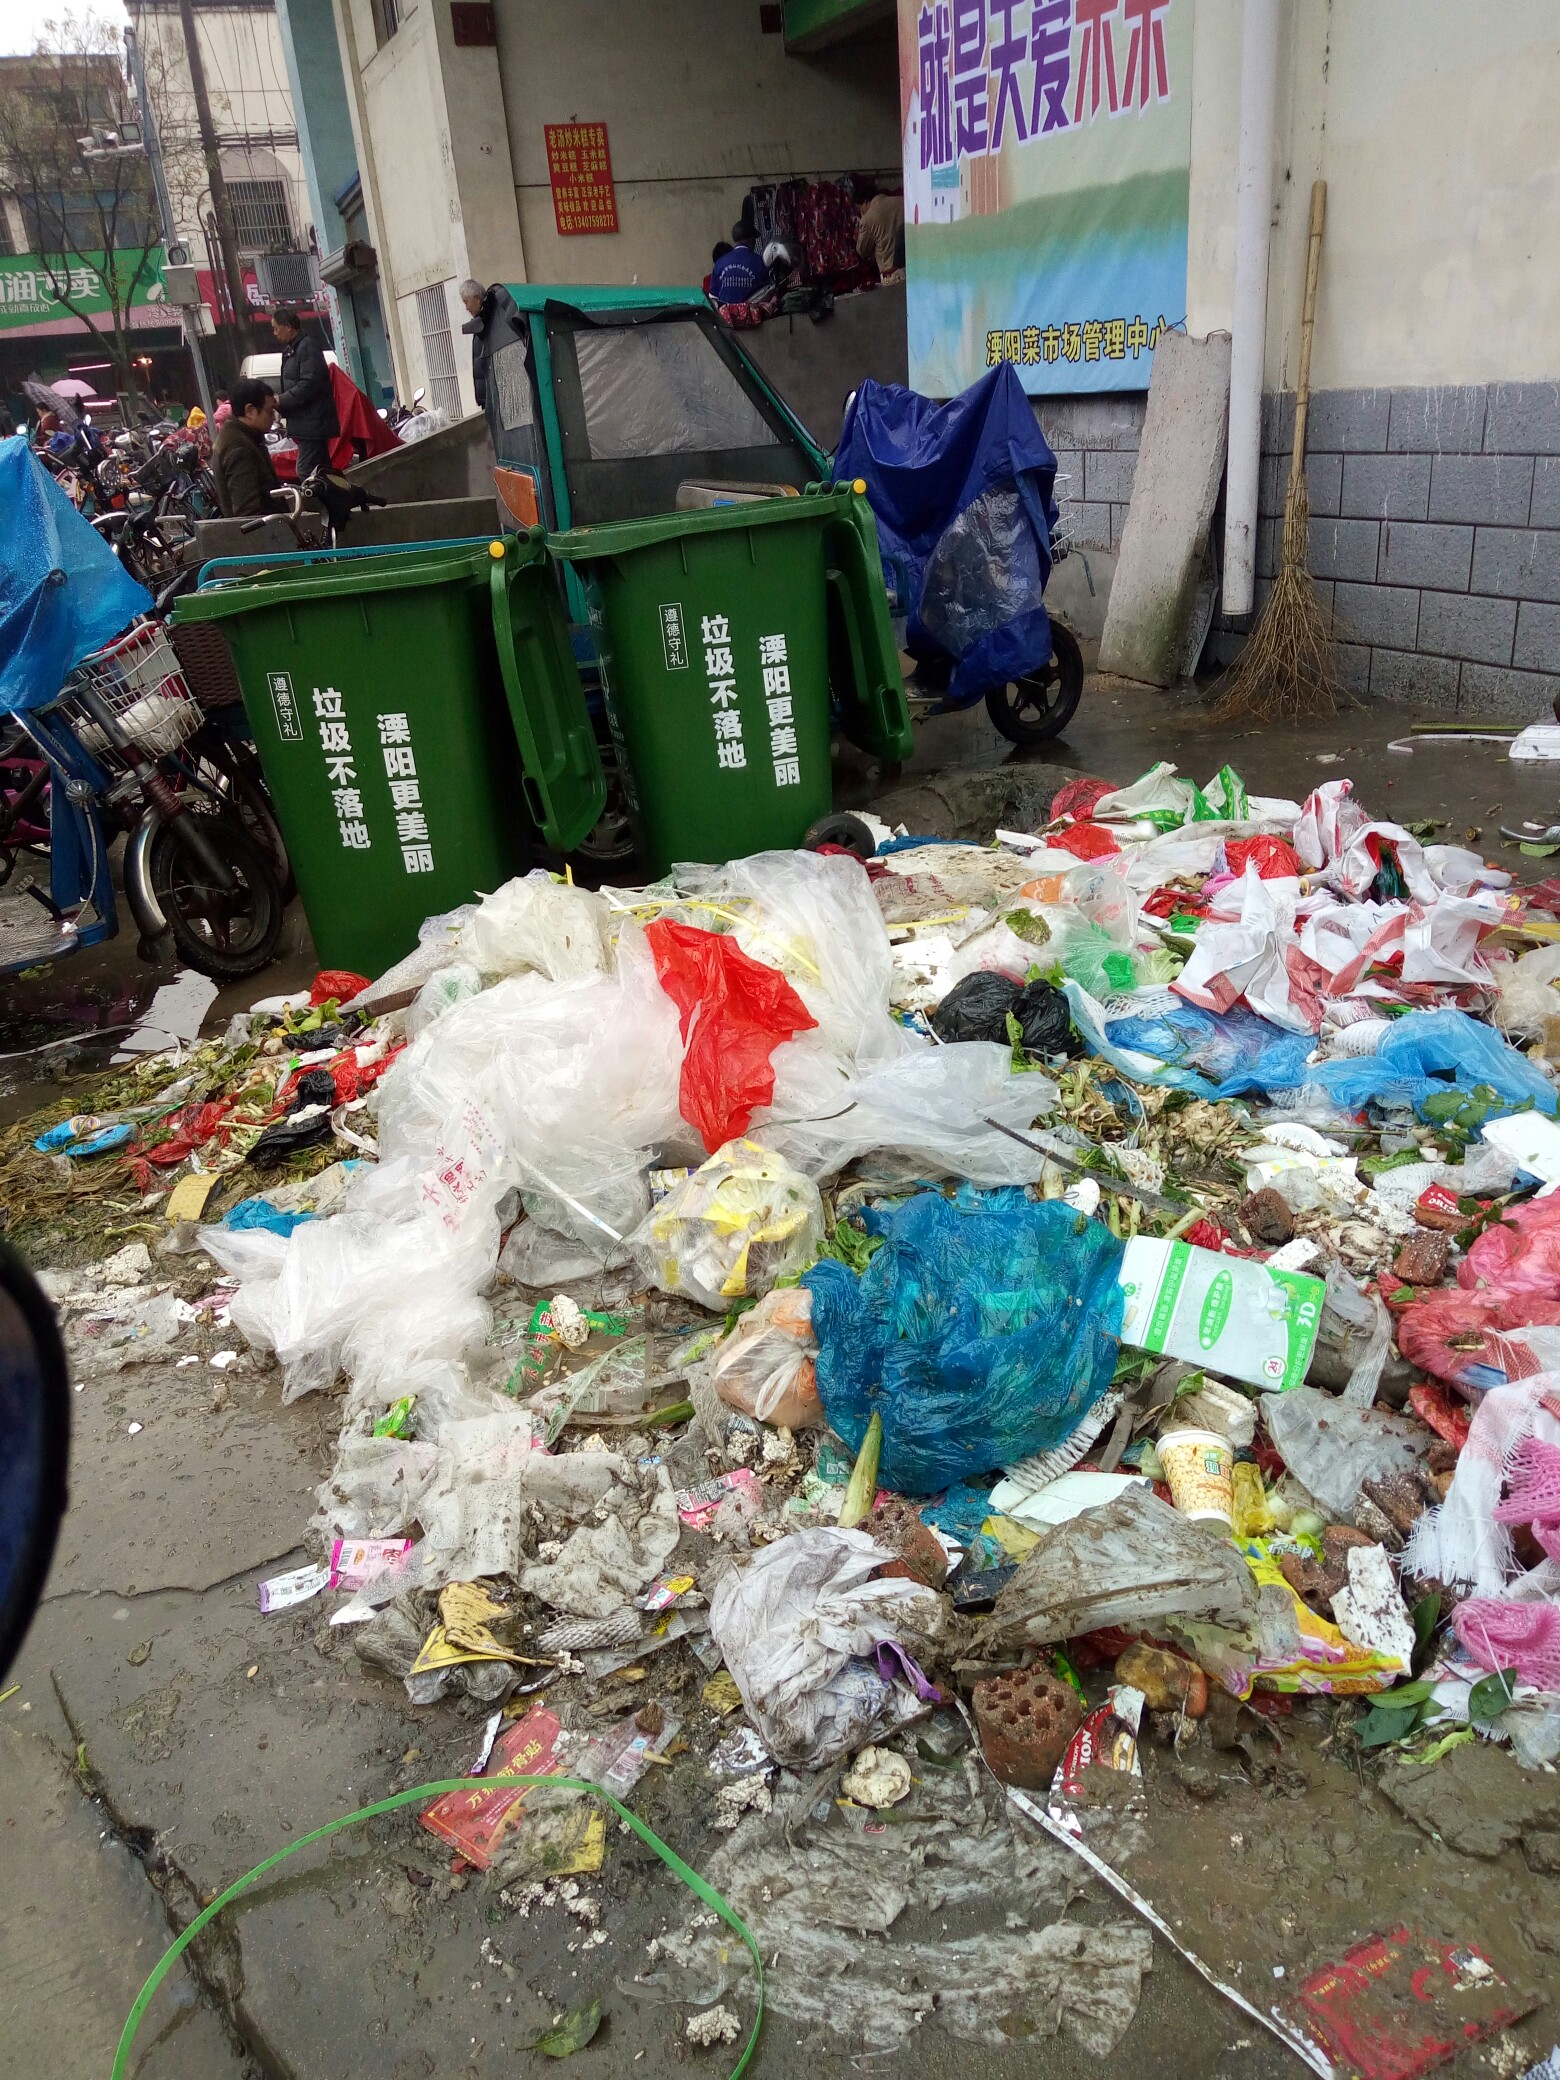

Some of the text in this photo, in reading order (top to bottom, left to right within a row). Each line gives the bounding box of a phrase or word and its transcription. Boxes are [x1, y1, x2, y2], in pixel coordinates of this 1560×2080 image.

[0, 267, 101, 306] 润专卖
[663, 608, 684, 666] 遵德守礼
[272, 676, 298, 737] 遵德守礼
[701, 613, 747, 769] 垃圾不落地
[758, 633, 801, 787] 溧阳更美丽
[312, 687, 371, 849] 垃圾不落地
[376, 712, 435, 874] 溧阳更美丽
[1296, 1302, 1317, 1329] 3D
